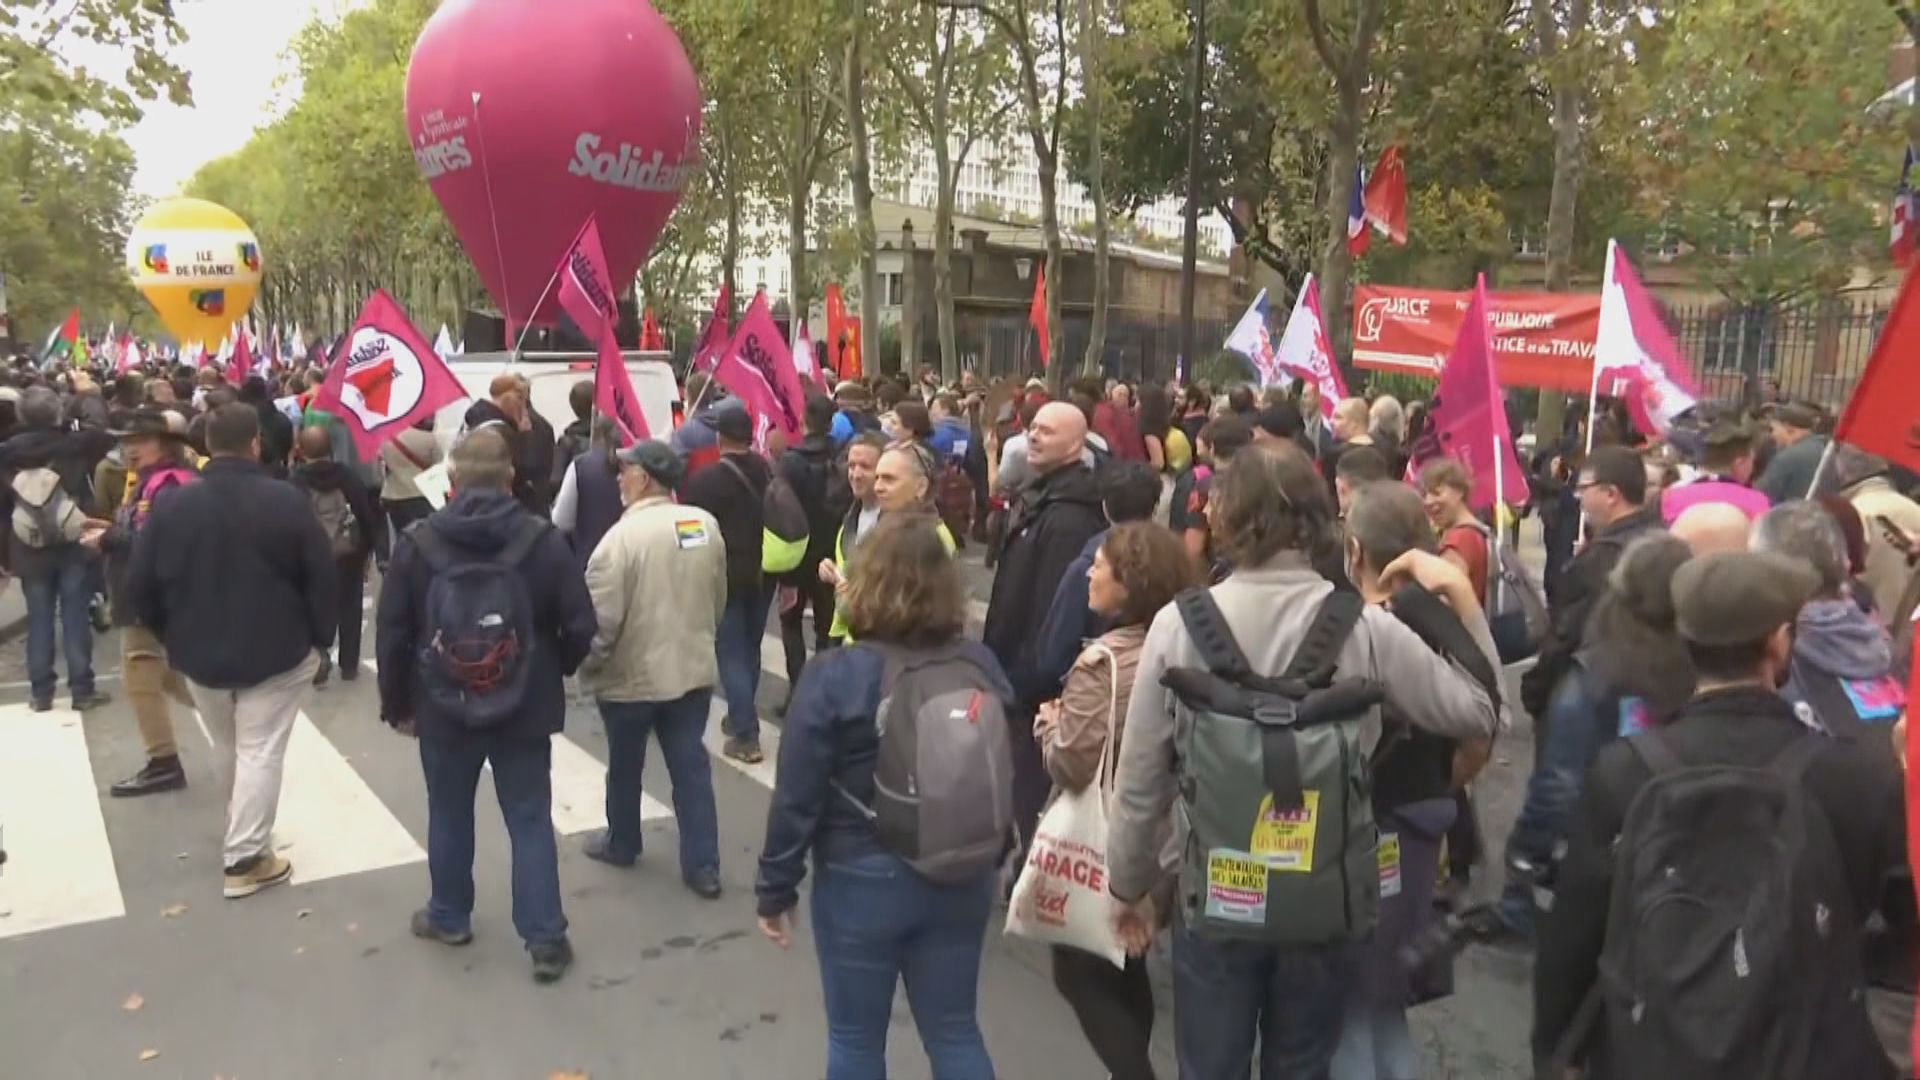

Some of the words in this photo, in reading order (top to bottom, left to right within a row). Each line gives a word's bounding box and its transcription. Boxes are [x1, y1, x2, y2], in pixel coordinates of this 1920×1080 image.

[195, 250, 214, 263] ILE
[175, 265, 190, 277] DE
[192, 264, 235, 277] FRANCE
